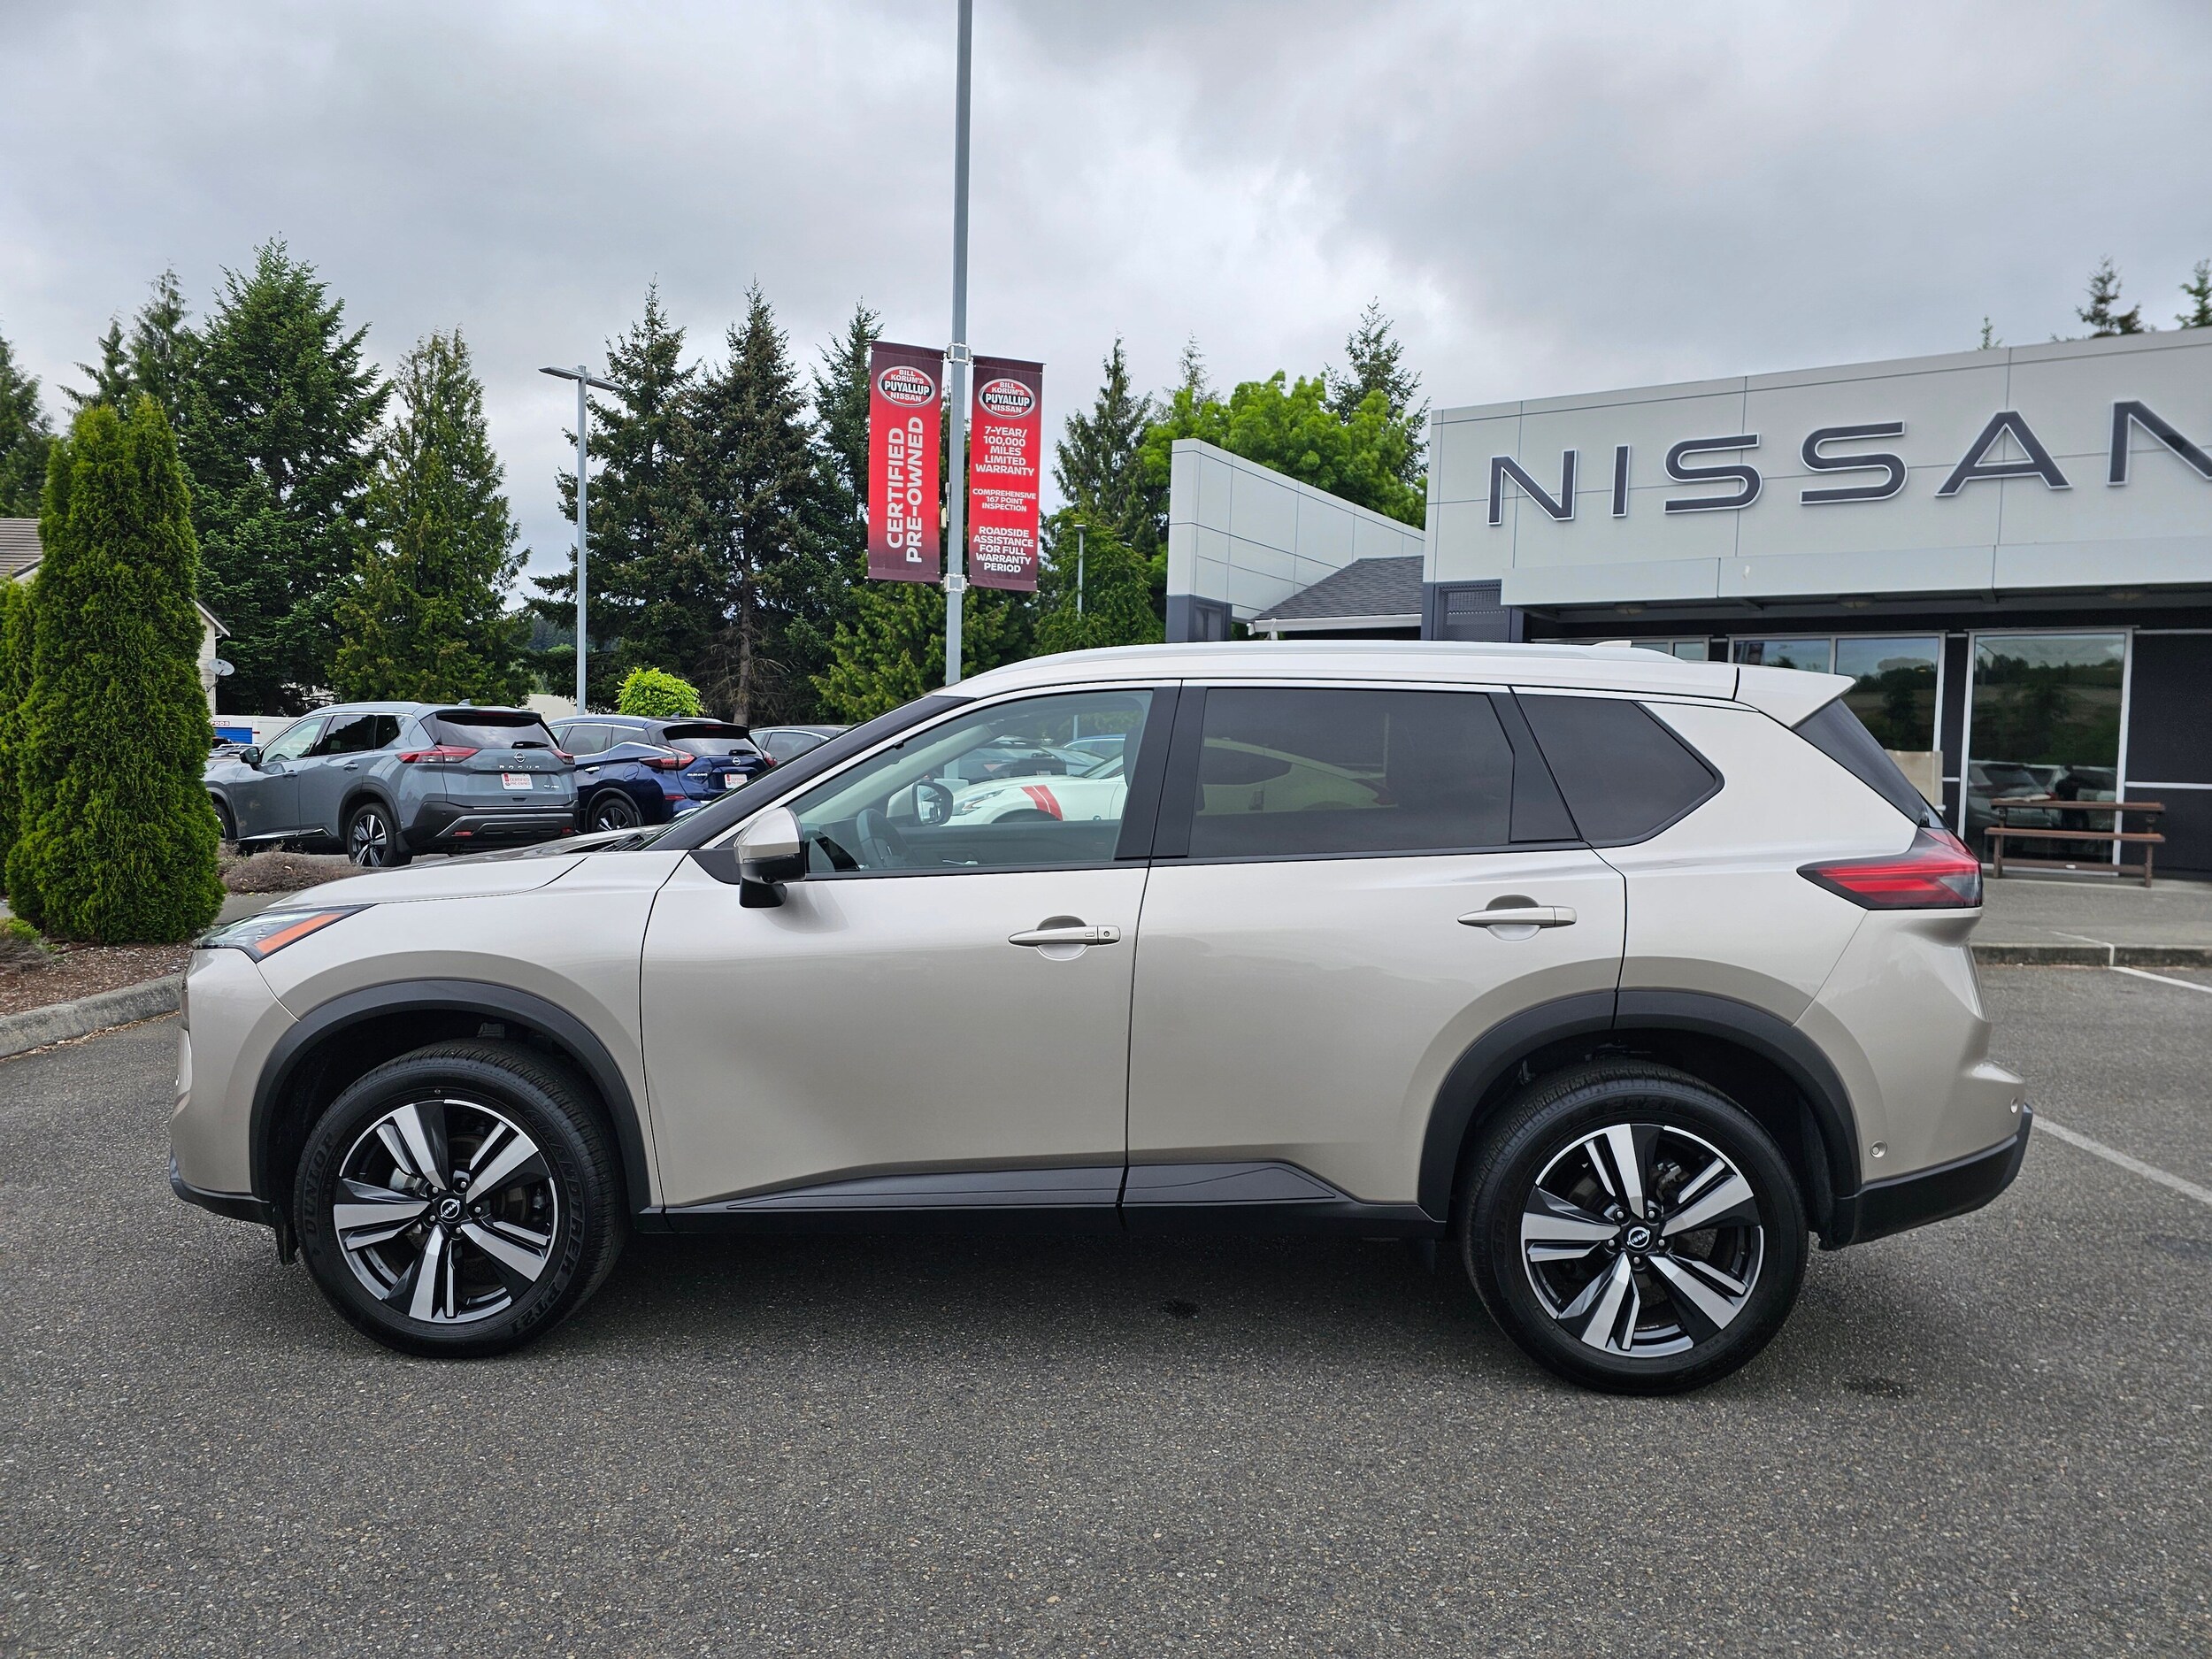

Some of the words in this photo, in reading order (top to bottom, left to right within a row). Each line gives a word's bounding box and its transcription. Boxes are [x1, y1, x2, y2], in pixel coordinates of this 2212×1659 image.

[891, 374, 925, 384] KORUM'S
[884, 380, 930, 396] PUYALLUP
[991, 387, 1025, 396] KORUM'S
[890, 392, 922, 402] NISSAN
[985, 393, 1031, 407] PUYALLUP
[991, 404, 1022, 413] NISSAN
[985, 426, 1027, 439] 7-YEAR/
[983, 435, 1026, 447] 100,000
[990, 446, 1022, 456] MILES
[985, 455, 1026, 466] LIMITED
[1487, 398, 2212, 526] NISSAN
[975, 464, 1034, 476] WARRANTY
[887, 427, 904, 549] CERTIFIED
[906, 416, 924, 563] PRE-OWNED
[972, 488, 1036, 500] COMPREHENSIVE
[981, 503, 1027, 511] INSPECTION
[979, 526, 1029, 538] ROADSIDE
[973, 534, 1034, 547] ASSISTANCE
[979, 544, 1001, 553] FOR
[1002, 546, 1026, 556] FULL
[976, 552, 1032, 565] WARRANTY
[984, 562, 1021, 573] PERIOD
[303, 1132, 334, 1234] DUNLOP
